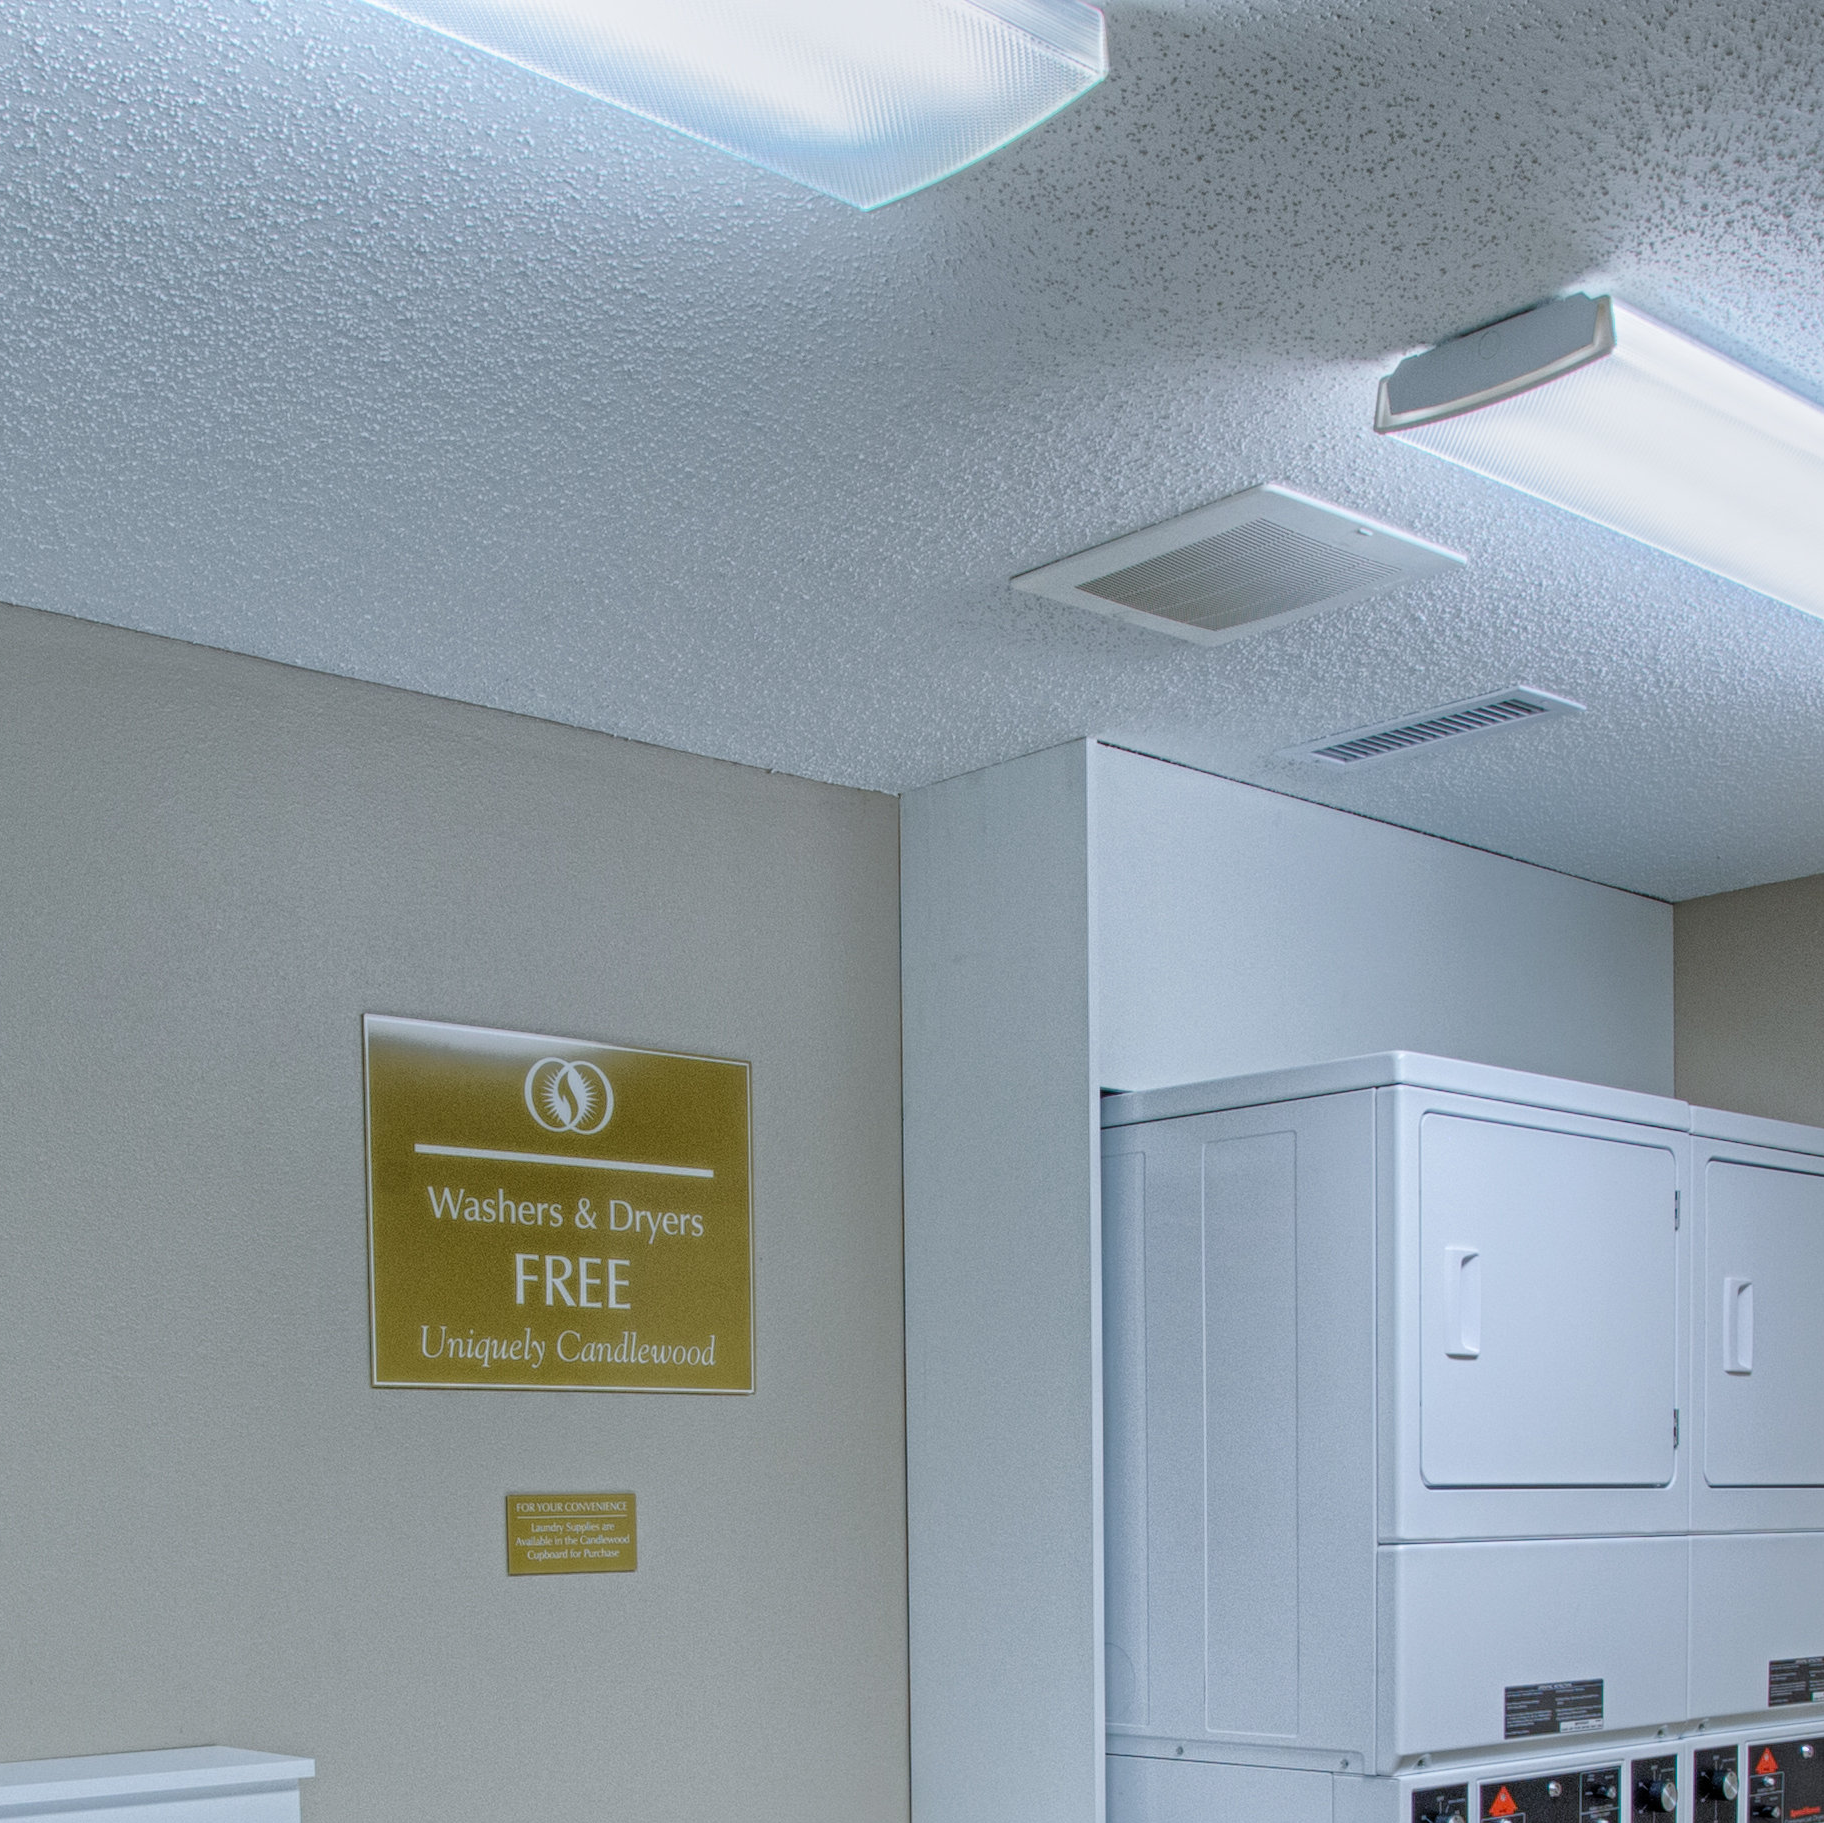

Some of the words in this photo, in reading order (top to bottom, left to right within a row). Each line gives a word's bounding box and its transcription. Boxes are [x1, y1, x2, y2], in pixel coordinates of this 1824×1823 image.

[427, 1185, 564, 1228] Washers
[574, 1197, 597, 1230] &
[609, 1199, 705, 1244] Dryers
[515, 1252, 632, 1310] FREE
[420, 1324, 546, 1368] Uniquely
[556, 1329, 716, 1367] Candlewood
[516, 1502, 536, 1513] FOR
[537, 1502, 564, 1513] YOUR
[564, 1501, 627, 1513] CONVENIENCE
[531, 1522, 564, 1534] Laundry
[566, 1521, 600, 1534] Supplies
[602, 1523, 615, 1531] are
[516, 1536, 554, 1546] Available
[554, 1536, 563, 1545] in
[565, 1536, 578, 1545] the
[579, 1534, 630, 1545] Candlewood
[527, 1549, 568, 1561] Cupboard
[570, 1549, 581, 1558] for
[583, 1548, 620, 1558] Purchase
